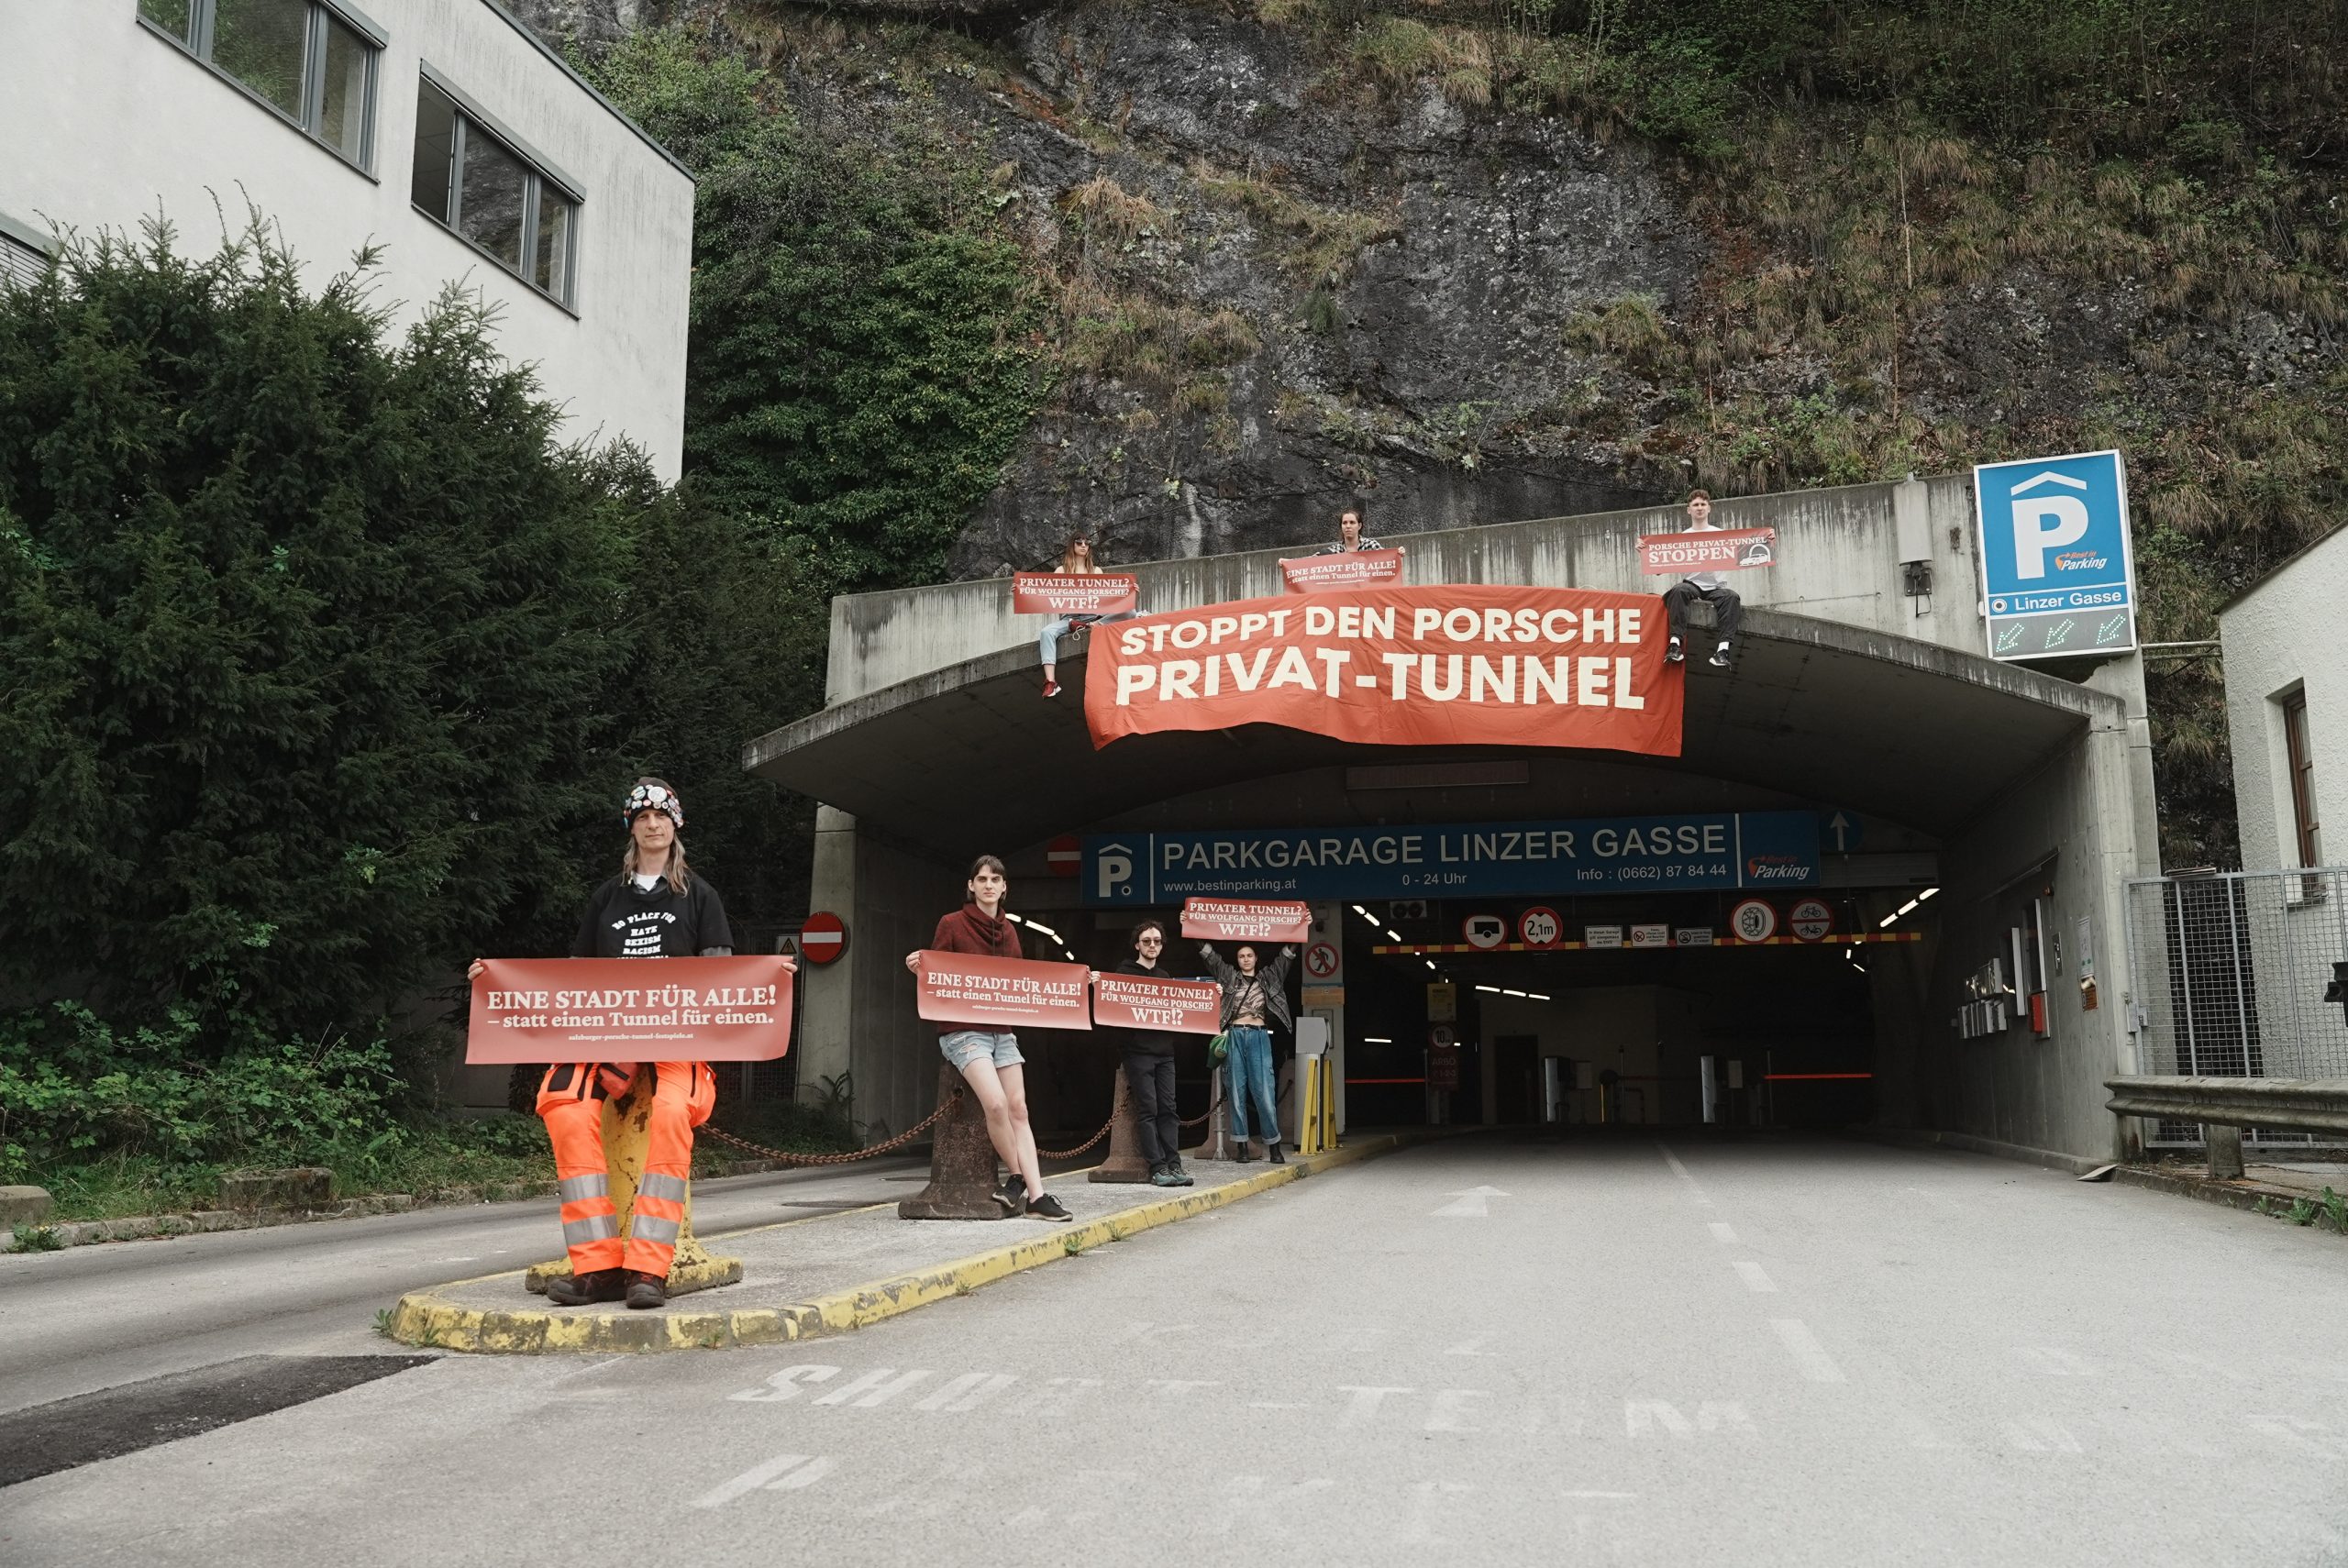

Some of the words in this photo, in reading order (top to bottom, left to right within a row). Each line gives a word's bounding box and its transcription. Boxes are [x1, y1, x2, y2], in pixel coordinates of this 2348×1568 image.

[1648, 542, 1691, 551] PORSCHE
[1693, 536, 1767, 548] PRIVAT-TUNNEL
[2011, 495, 2088, 580] P
[1648, 546, 1736, 564] STOPPEN
[2061, 557, 2107, 570] Parking
[1286, 568, 1309, 579] EINE
[1310, 564, 1344, 574] STADT
[1345, 562, 1366, 572] FÜR
[1366, 559, 1396, 569] ALLE!
[1291, 575, 1308, 583] statt
[1309, 572, 1330, 580] einen
[1331, 571, 1358, 580] Tunnel
[1358, 569, 1371, 578] für
[1371, 569, 1396, 577] einen.
[1019, 578, 1075, 587] PRIVATER
[1077, 578, 1130, 588] TUNNEL?
[1019, 587, 1037, 595] FÜR
[1087, 588, 1130, 596] PORSCHE?
[1048, 596, 1100, 610] WTF!?
[2014, 596, 2065, 611] Linzer
[2069, 591, 2122, 605] Gasse
[1120, 608, 1292, 656] STOPPT
[1305, 605, 1394, 640] DEN
[1412, 606, 1642, 644] PORSCHE
[1115, 645, 1645, 711] PRIVAT-TUNNEL
[1163, 834, 1423, 871] PARKGARAGE
[1440, 830, 1577, 863] LINZER
[1591, 824, 1727, 857] GASSE
[1099, 856, 1132, 898] P
[1401, 874, 1410, 886] 0
[1423, 873, 1439, 885] 24
[1444, 872, 1468, 885] Uhr
[1577, 867, 1603, 881] Info
[1617, 866, 1662, 882] (0662)
[1666, 866, 1682, 877] 87
[1688, 865, 1705, 877] 84
[1709, 864, 1727, 877] 44
[1754, 864, 1811, 880] Parking
[1163, 877, 1297, 893] www.bestinparking.at
[626, 911, 660, 923] PLACE
[1189, 911, 1207, 921] FÜR
[1208, 913, 1257, 922] WOLFGANG
[1258, 915, 1302, 924] PORSCHE?
[1190, 902, 1246, 913] PRIVATER
[1248, 904, 1302, 916] TUNNEL?
[630, 925, 659, 936] HATE
[1219, 922, 1271, 937] WTF!?
[1526, 920, 1554, 937] 2,1m
[625, 933, 661, 946] SEXISM
[623, 944, 661, 955] RACISM
[927, 971, 962, 986] EINE
[965, 975, 1011, 991] STADT
[1012, 977, 1041, 993] FÜR
[1043, 982, 1081, 997] ALLE!
[1101, 979, 1158, 996] PRIVATER
[1161, 986, 1213, 1000] TUNNEL?
[487, 990, 549, 1010] EINE
[555, 989, 640, 1009] STADT
[646, 984, 698, 1008] FÜR
[702, 984, 777, 1008] ALLE!
[936, 988, 961, 999] statt
[962, 990, 991, 1001] einen
[993, 991, 1031, 1004] Tunnel
[1032, 993, 1047, 1005] für
[1049, 996, 1080, 1008] einen.
[1101, 992, 1119, 1002] FÜR
[1119, 994, 1169, 1007] WOLFGANG
[1170, 999, 1213, 1010] PORSCHE?
[503, 1012, 548, 1028] statt
[551, 1010, 605, 1028] einen
[609, 1009, 678, 1027] Tunnel
[681, 1008, 711, 1026] für
[714, 1008, 775, 1025] einen.
[1131, 1007, 1184, 1026] WTF!?
